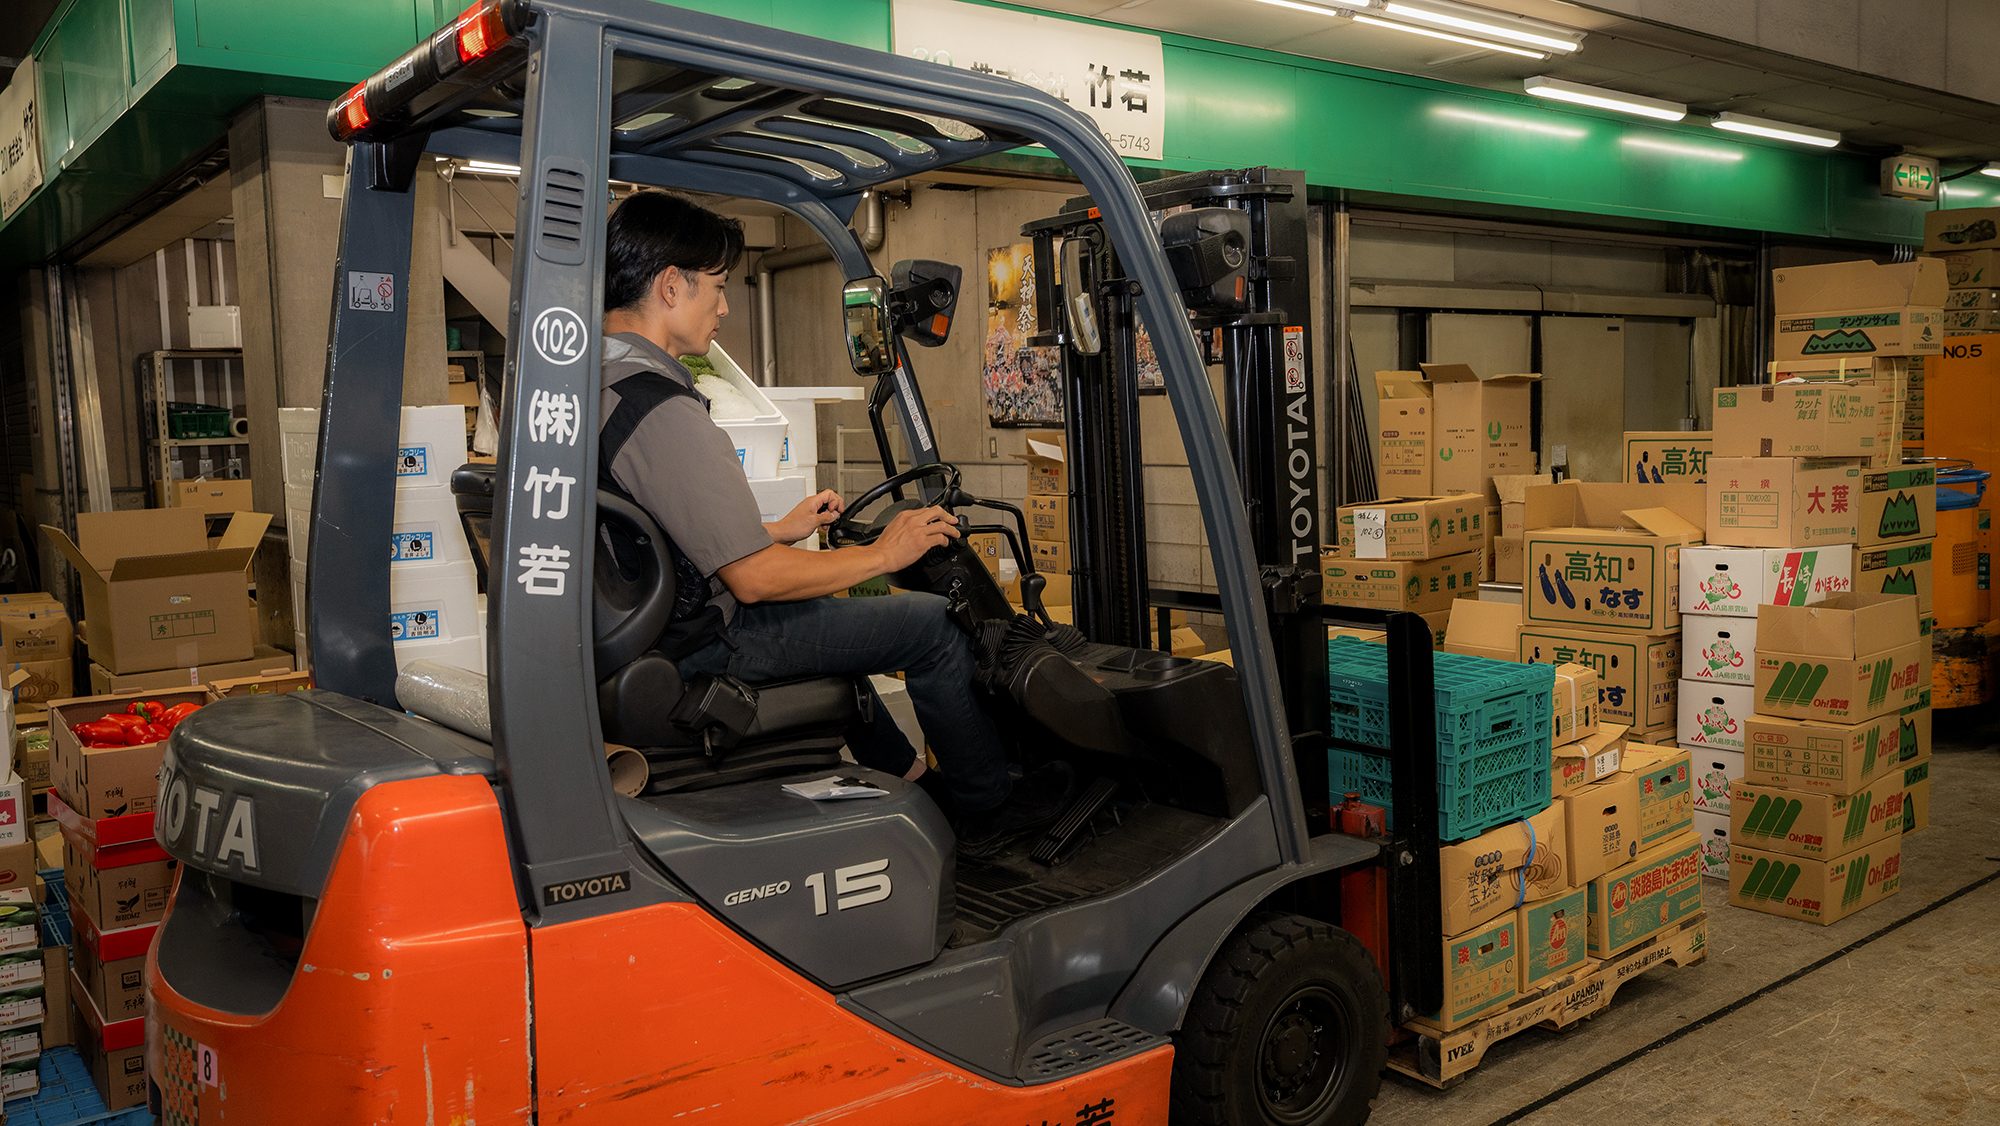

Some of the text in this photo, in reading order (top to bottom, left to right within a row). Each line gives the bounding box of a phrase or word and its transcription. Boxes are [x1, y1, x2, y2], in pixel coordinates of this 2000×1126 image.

[1085, 63, 1151, 114] 竹若
[1017, 254, 1037, 332] 天神祭
[537, 314, 579, 359] 102
[1944, 344, 1983, 360] NO.5
[1795, 397, 1822, 409] カット
[399, 449, 425, 457] ロッコリー
[1661, 447, 1713, 477] 高知
[1286, 394, 1313, 564] TOYOTA
[1807, 485, 1849, 514] 大葉
[1565, 551, 1623, 584] 高知
[1600, 586, 1644, 610] なす
[1815, 575, 1849, 594] かぼちゃ
[406, 612, 437, 621] ブロリー
[1553, 645, 1606, 681] 高知
[1598, 685, 1627, 708] す
[1803, 751, 1812, 761] B
[1819, 766, 1841, 777] 10袋入
[548, 874, 627, 903] TOYOTA
[723, 857, 893, 917] GENEO 15
[1629, 847, 1699, 906] 淡路島たまねぎ
[1565, 979, 1605, 1006] LAPANDAY
[203, 1049, 212, 1082] 8
[1447, 1040, 1475, 1063] IVEE
